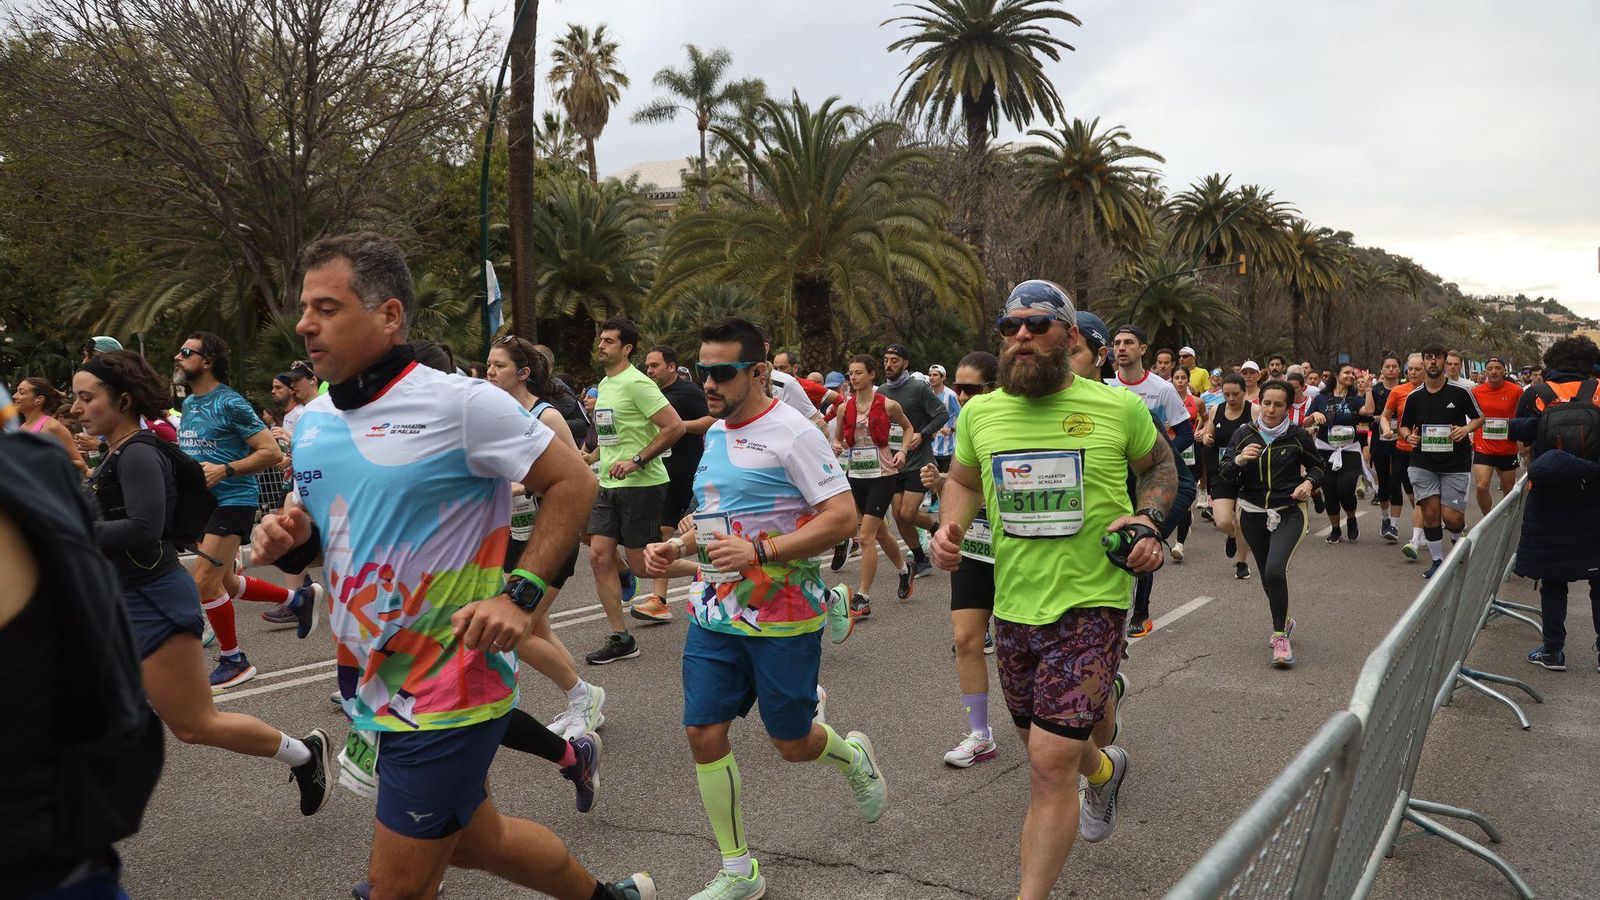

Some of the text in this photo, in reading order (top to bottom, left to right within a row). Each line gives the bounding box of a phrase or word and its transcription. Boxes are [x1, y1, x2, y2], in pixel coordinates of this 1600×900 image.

[296, 470, 322, 483] aga
[1014, 490, 1066, 512] 5117
[346, 731, 369, 764] 37
